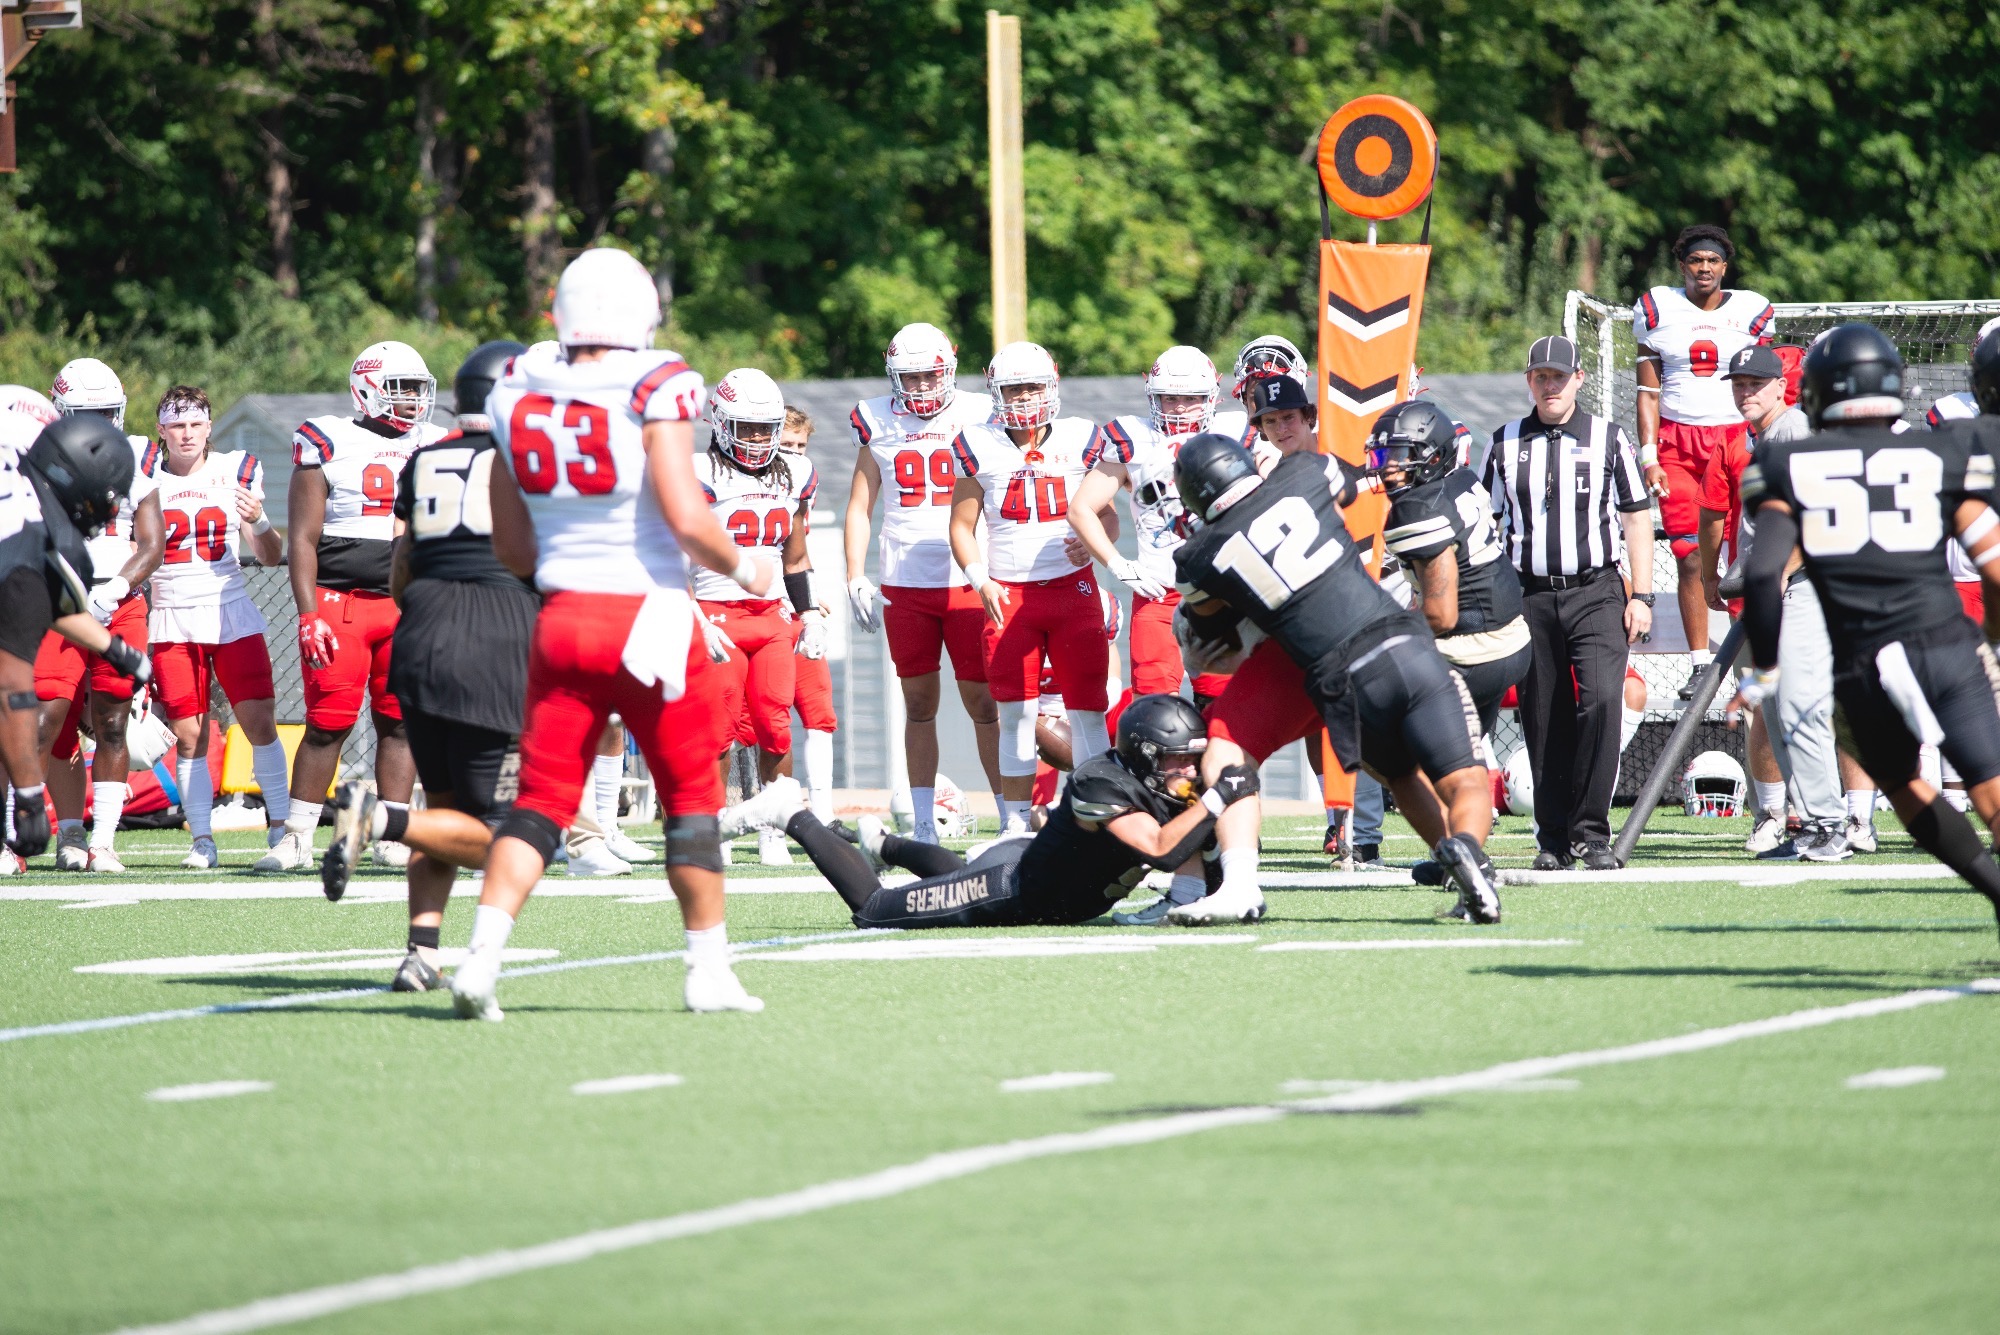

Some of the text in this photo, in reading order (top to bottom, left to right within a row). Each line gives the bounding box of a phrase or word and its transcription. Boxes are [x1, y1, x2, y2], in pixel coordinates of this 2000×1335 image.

[1738, 349, 1754, 366] F
[1267, 381, 1281, 401] F
[511, 392, 617, 495] 63
[1519, 450, 1529, 462] S
[362, 463, 395, 516] 9
[894, 449, 957, 507] 99
[1576, 476, 1589, 493] L
[1000, 476, 1069, 525] 40
[1789, 447, 1944, 557] 53
[162, 506, 228, 564] 20
[726, 507, 791, 547] 30
[1212, 496, 1344, 611] 12
[1078, 580, 1093, 594] SU
[906, 874, 990, 913] PANTHERS
